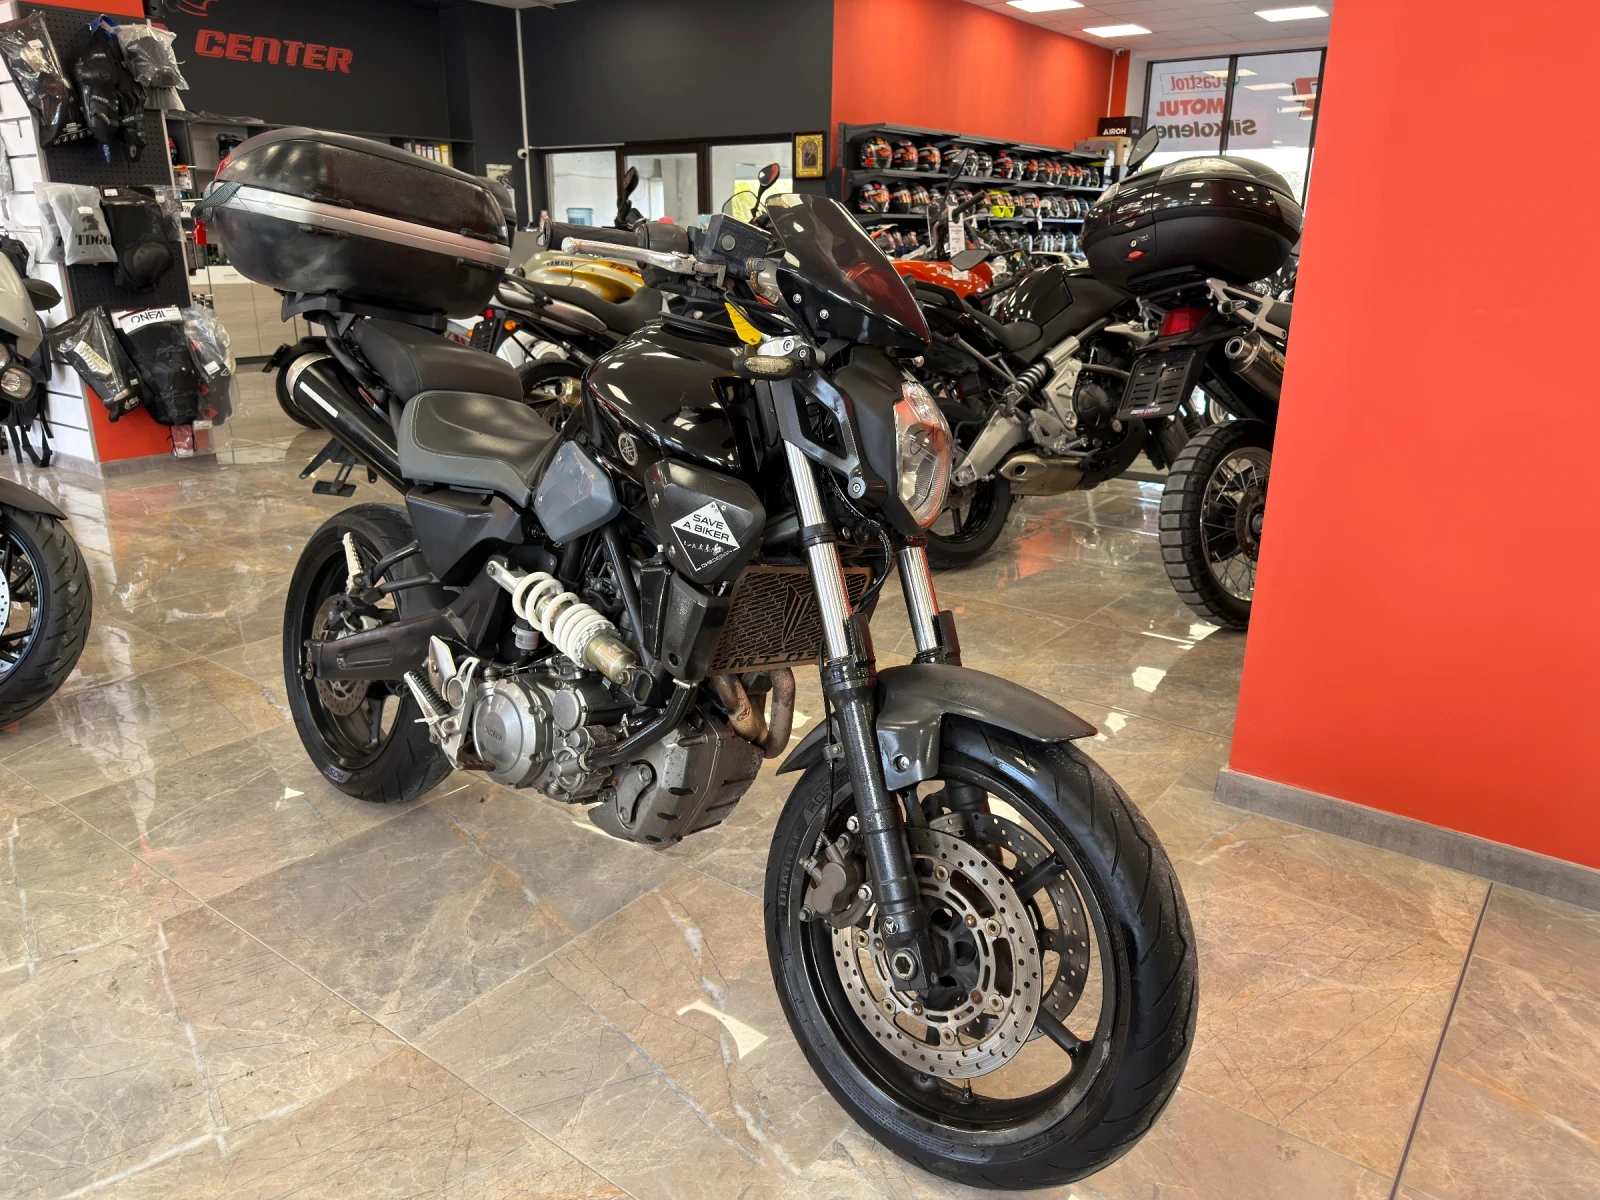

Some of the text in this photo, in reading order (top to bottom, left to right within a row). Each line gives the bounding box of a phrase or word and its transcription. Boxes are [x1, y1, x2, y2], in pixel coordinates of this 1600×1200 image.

[195, 29, 354, 74] CENTER
[1103, 128, 1127, 136] AIROH
[546, 260, 574, 268] YAMAHA
[692, 513, 725, 530] SAVE
[682, 521, 730, 542] A BIKER
